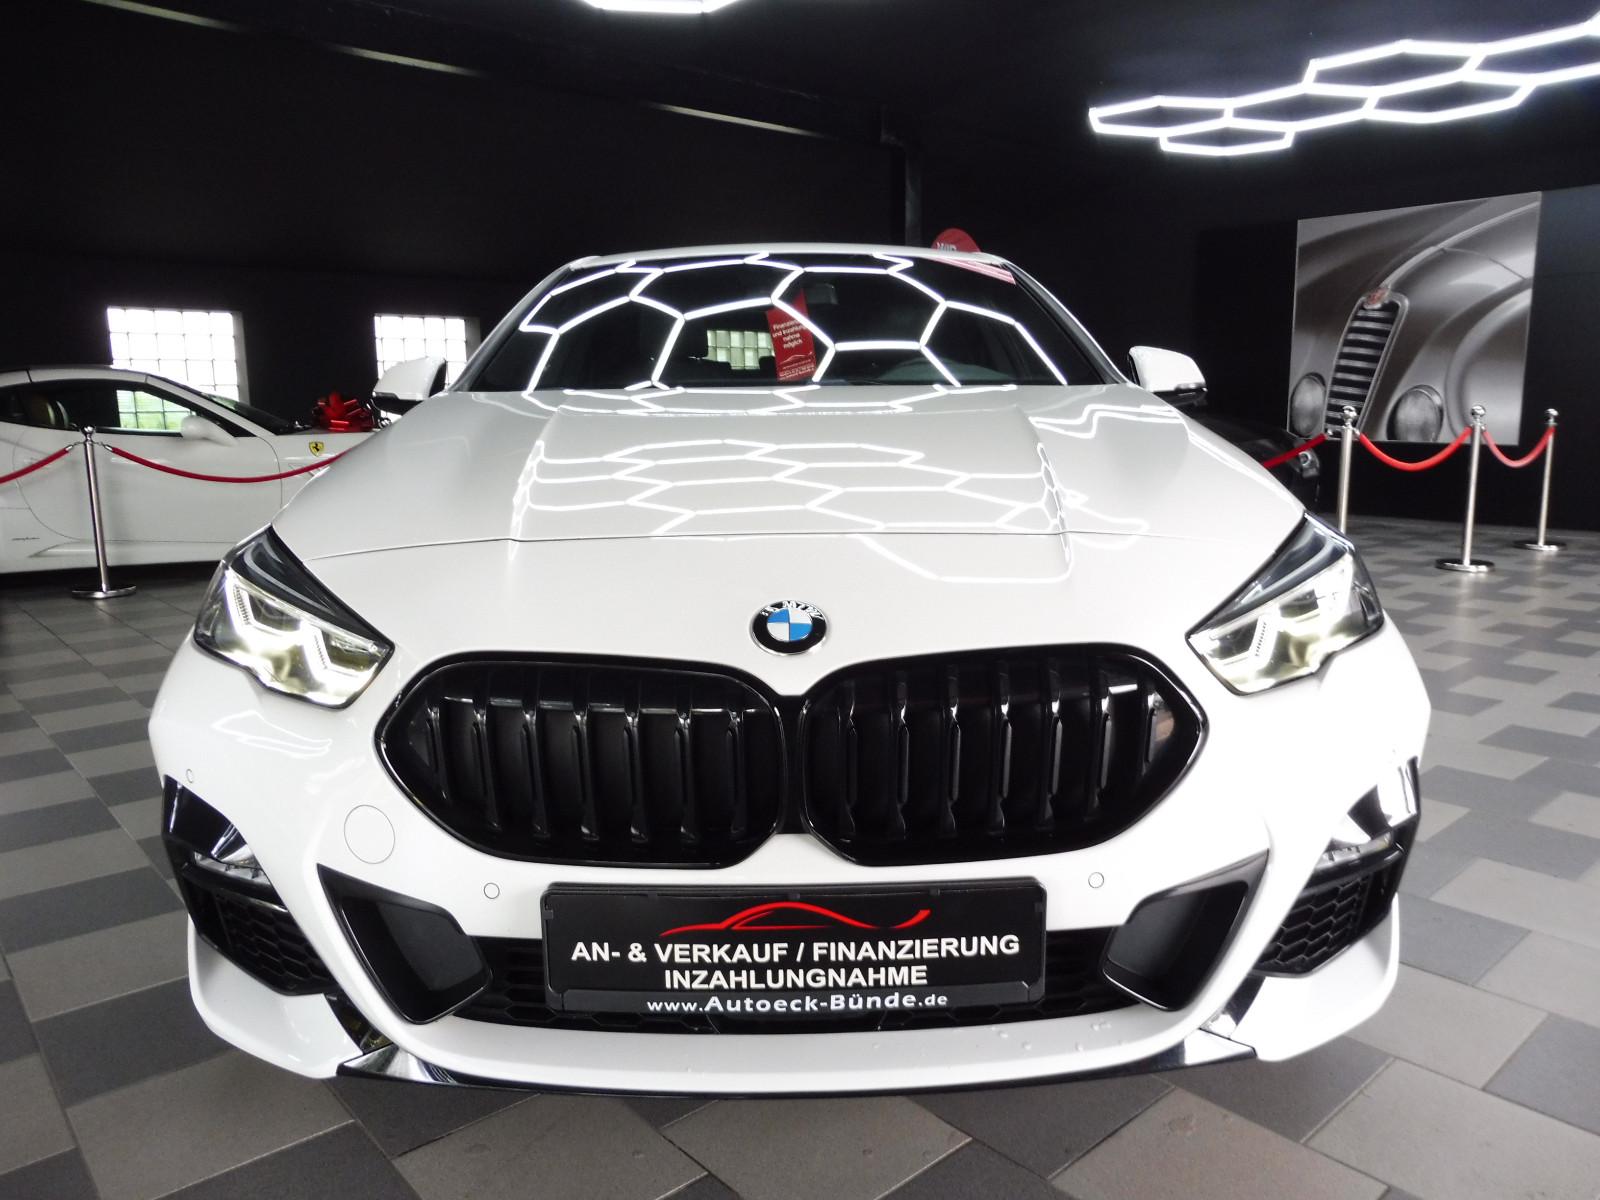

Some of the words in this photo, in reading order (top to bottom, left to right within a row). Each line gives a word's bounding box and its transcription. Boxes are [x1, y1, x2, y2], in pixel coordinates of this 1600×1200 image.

[570, 942, 621, 962] AN-
[627, 942, 648, 963] &
[654, 942, 789, 964] VERKAUF
[795, 941, 805, 963] /
[812, 933, 1020, 962] FINANZIERUNG
[664, 965, 928, 990] INZAHLUNGNAHME
[646, 991, 949, 1014] www.Autoeck-Bünde.de
